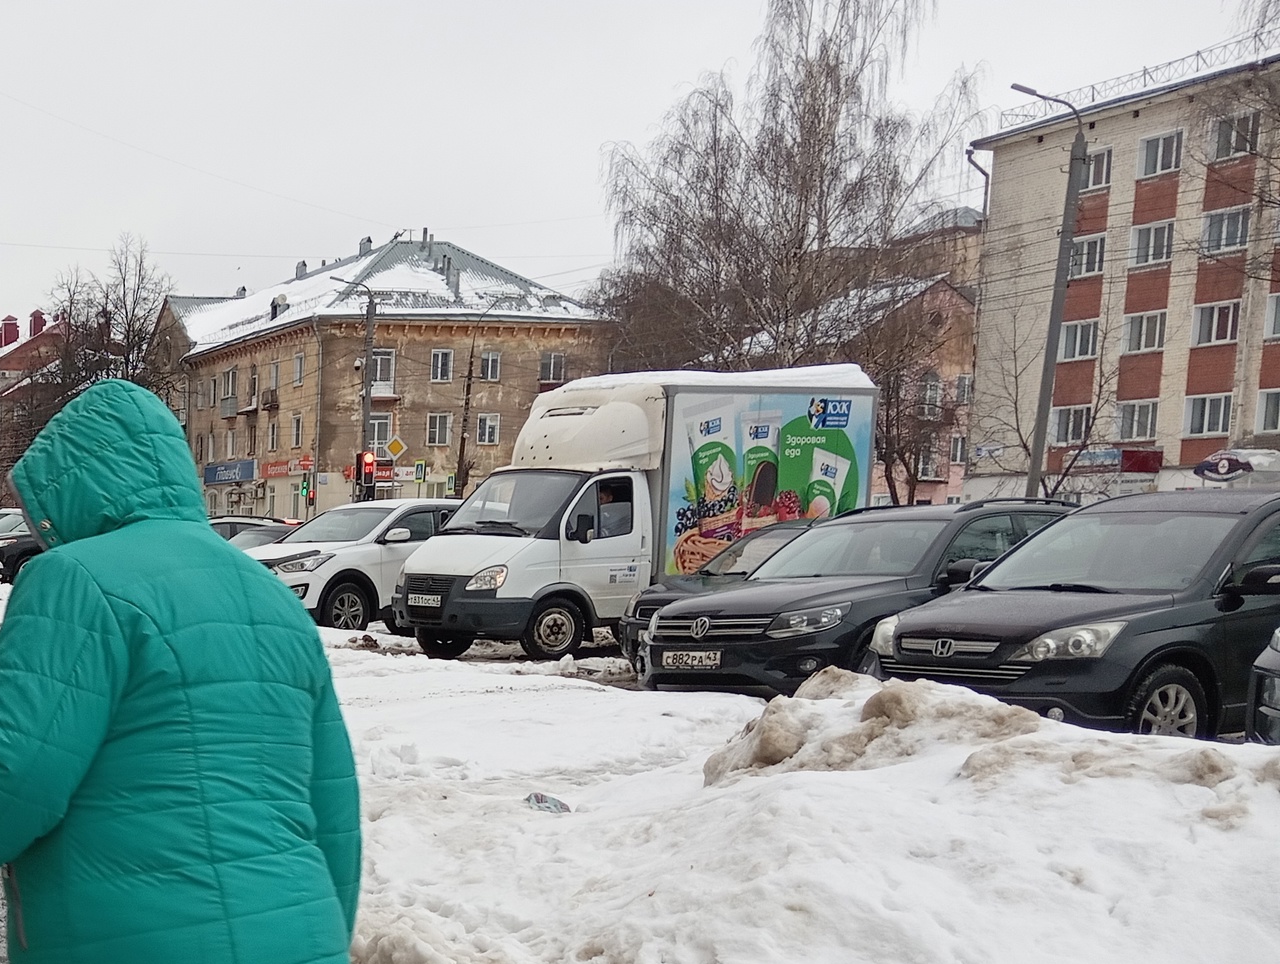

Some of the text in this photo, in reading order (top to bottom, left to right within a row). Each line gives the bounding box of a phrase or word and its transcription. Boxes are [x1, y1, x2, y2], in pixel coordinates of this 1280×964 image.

[827, 401, 849, 414] КХК
[785, 434, 826, 446] Здоровая
[785, 448, 800, 458] еда
[665, 652, 718, 666] С882РА 43
